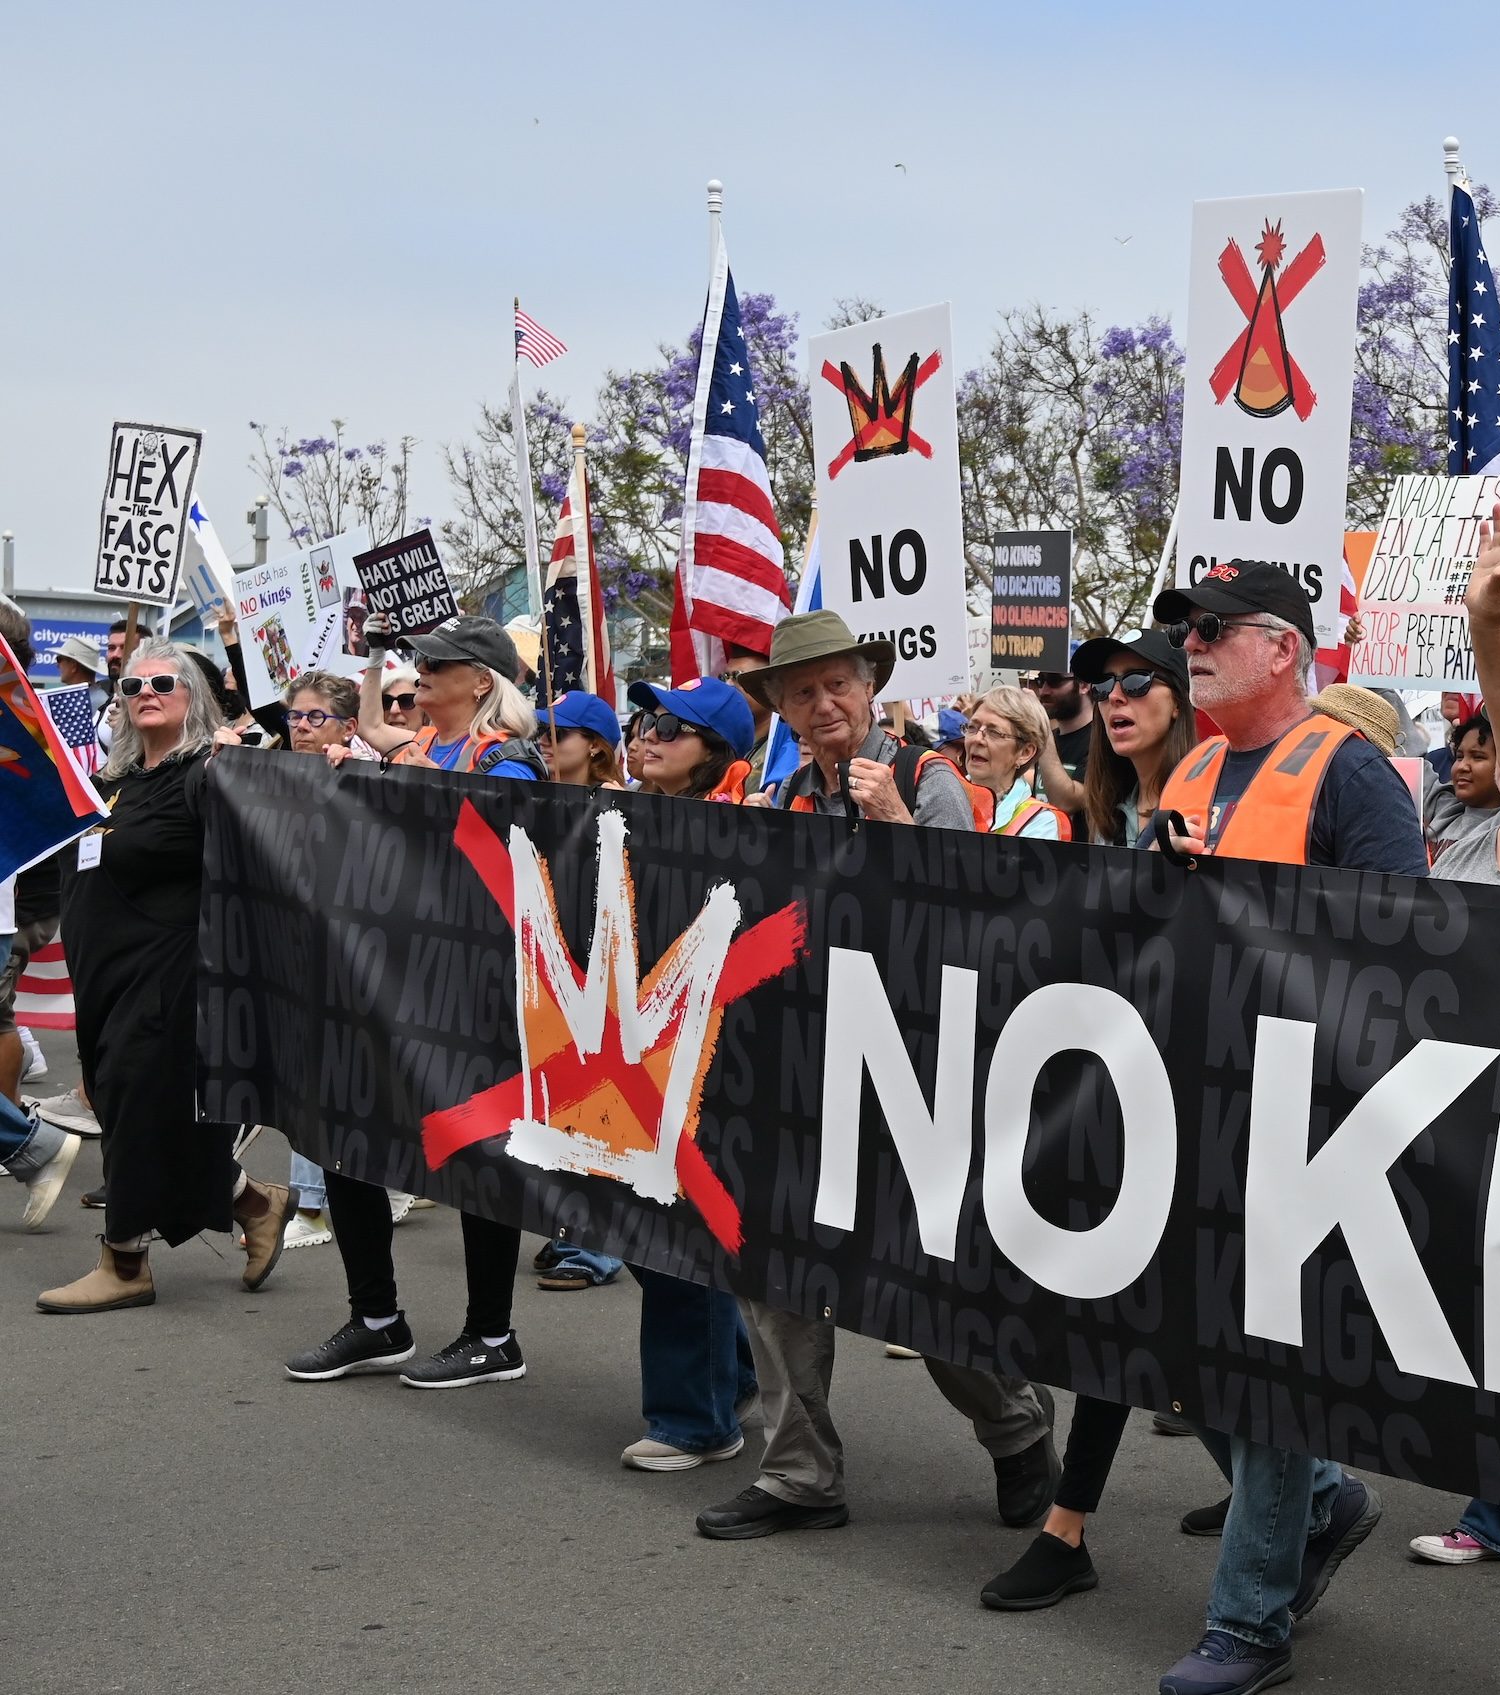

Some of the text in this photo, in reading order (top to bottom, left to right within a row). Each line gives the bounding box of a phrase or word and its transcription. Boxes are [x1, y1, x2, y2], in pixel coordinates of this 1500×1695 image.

[109, 435, 190, 509] HEX
[1213, 446, 1304, 525] NO
[1389, 476, 1470, 519] NADIE
[104, 515, 175, 559] FASC
[994, 545, 1042, 567] NO KINGS
[1377, 517, 1412, 556] EN
[1413, 518, 1447, 557] LA
[100, 553, 170, 594] ISTS
[236, 565, 289, 593] The USA has
[360, 544, 437, 589] HATE WILL
[849, 528, 927, 603] NO
[993, 575, 1061, 597] NO DICATORS
[1363, 556, 1425, 603] DIOS
[239, 585, 292, 616] NO Kings
[300, 562, 317, 624] JOKERS
[368, 568, 447, 613] NOT MAKE
[401, 592, 452, 628] GREAT
[992, 605, 1068, 628] NO OLIGARCHS
[1359, 610, 1401, 643] STOP
[992, 635, 1044, 657] NO TRUMP
[1352, 642, 1408, 677] RACISM
[1415, 645, 1434, 678] IS
[333, 820, 407, 916] NO
[325, 918, 388, 1017] NO
[319, 1018, 377, 1118] NO
[814, 946, 1178, 1301] NO
